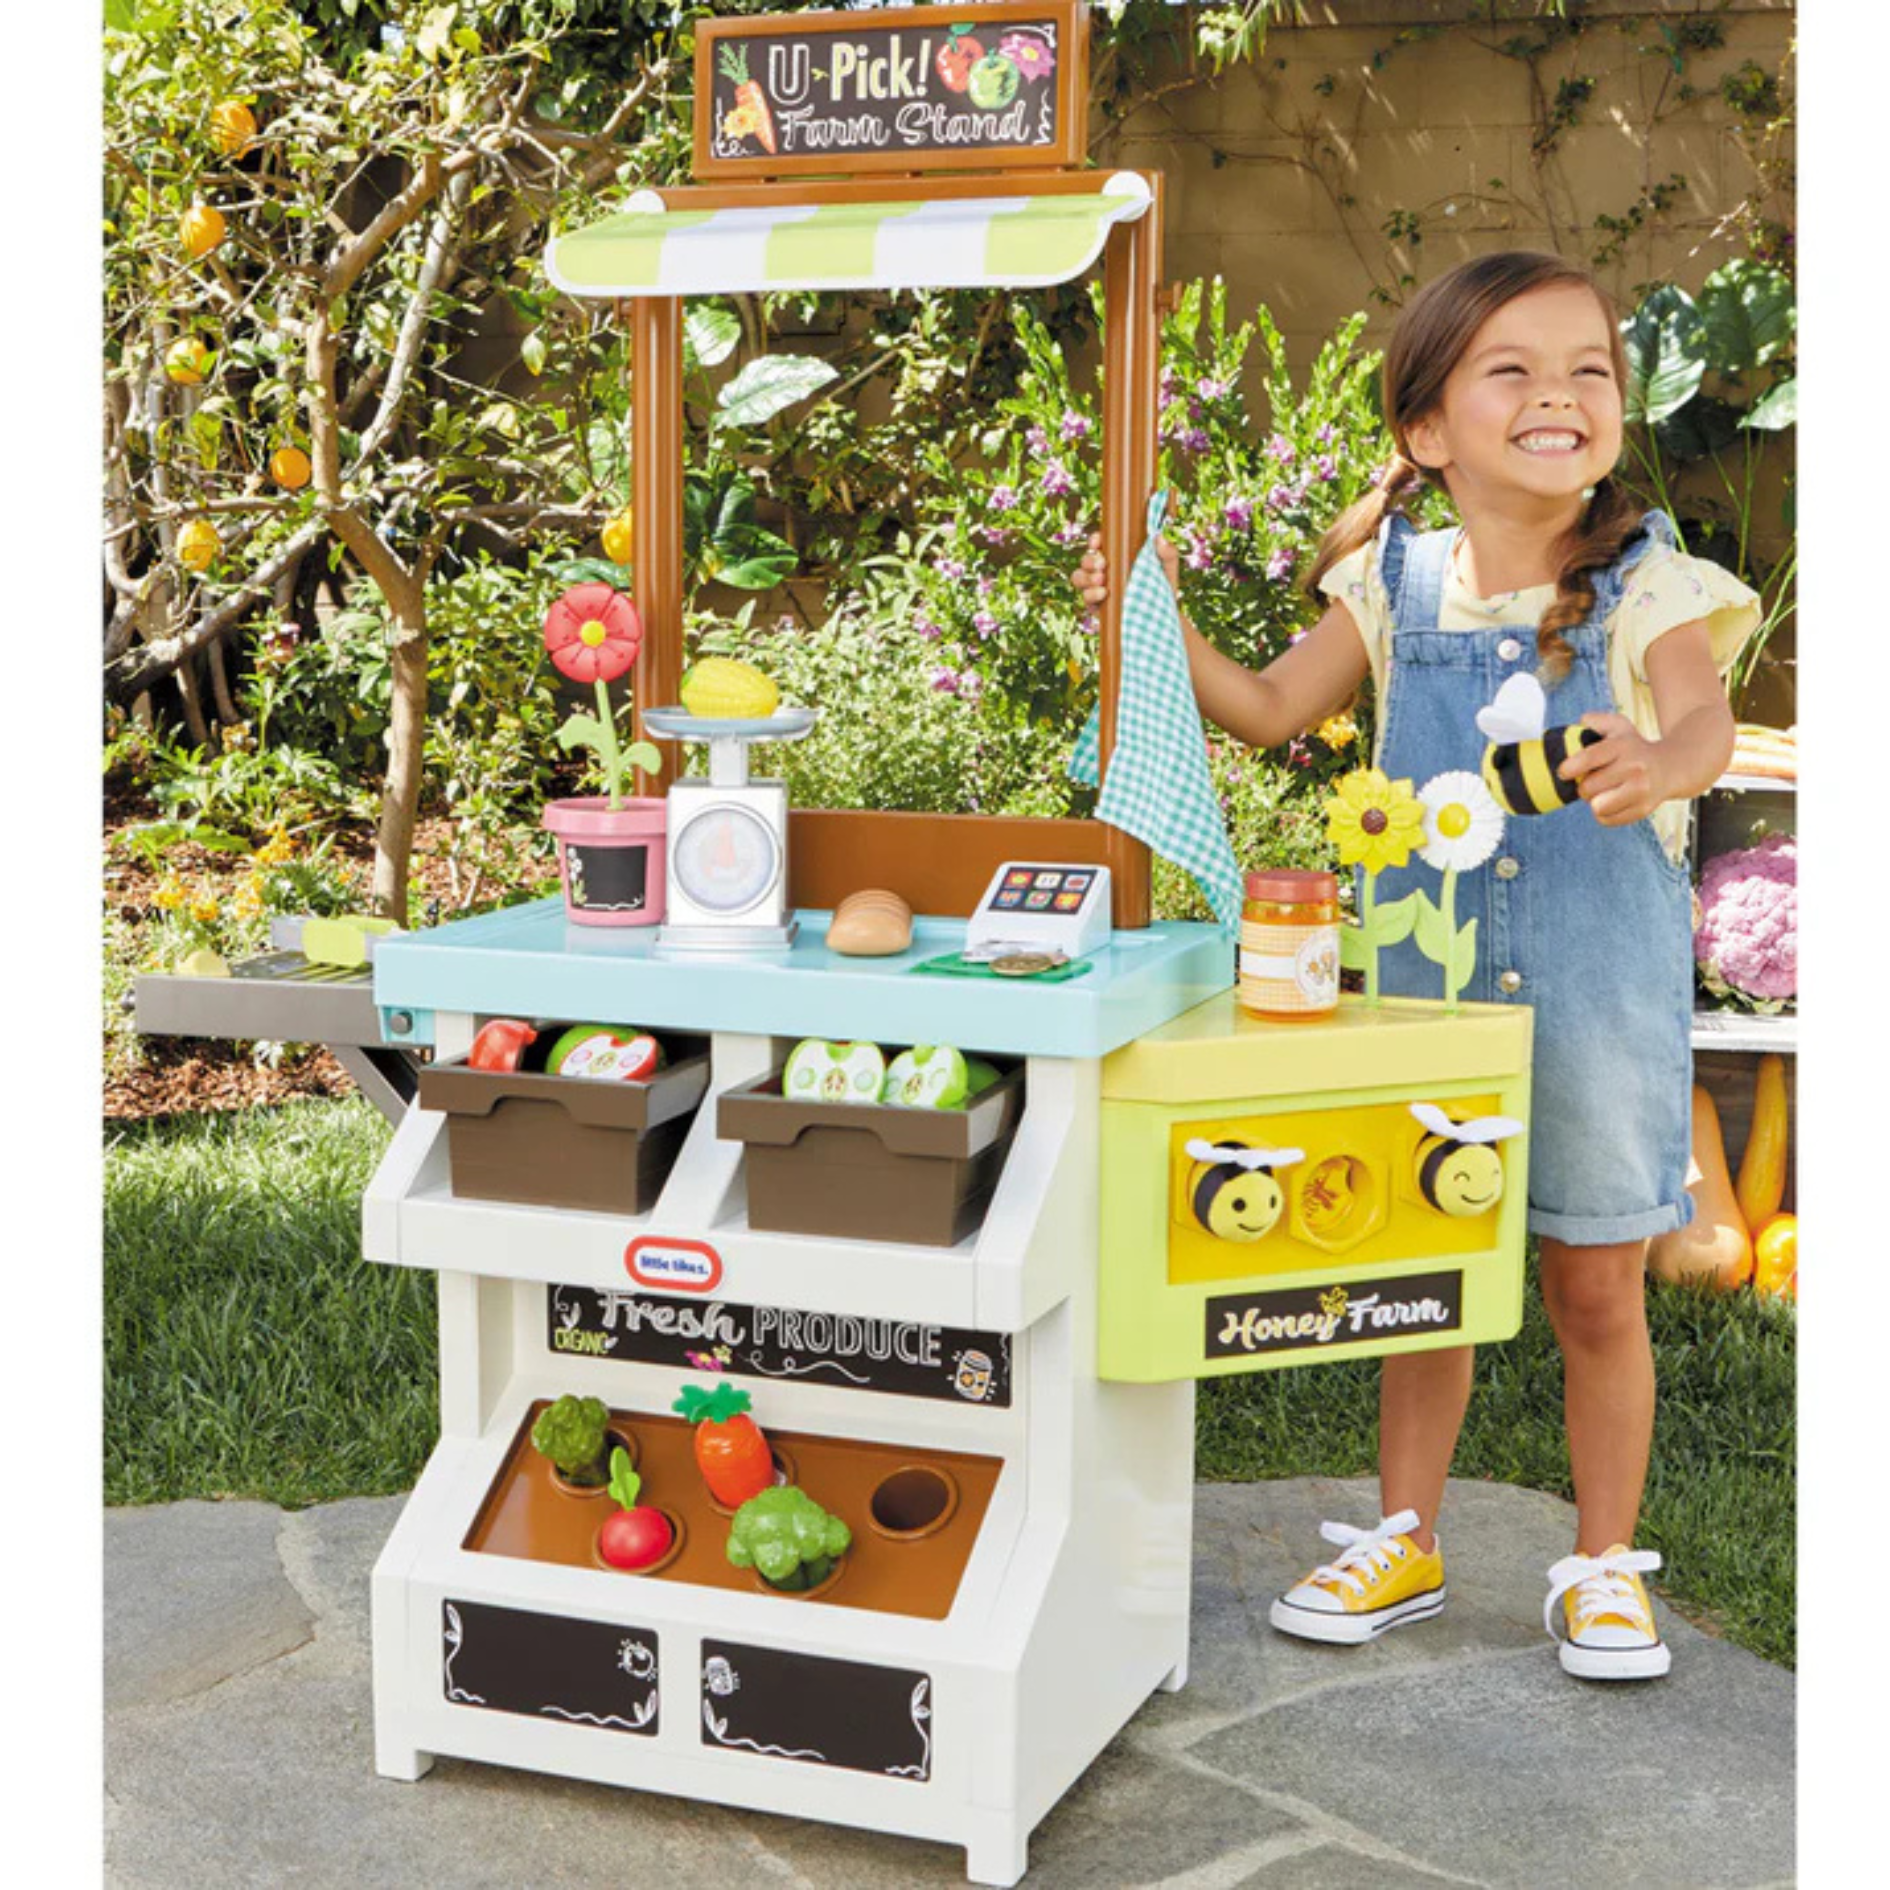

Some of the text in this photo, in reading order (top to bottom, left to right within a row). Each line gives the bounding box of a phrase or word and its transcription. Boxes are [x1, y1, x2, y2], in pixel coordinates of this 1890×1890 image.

[776, 99, 1030, 150] Farm Stand
[597, 1290, 943, 1367] Fresh PRODUCE
[1217, 1293, 1449, 1350] Honey Farm
